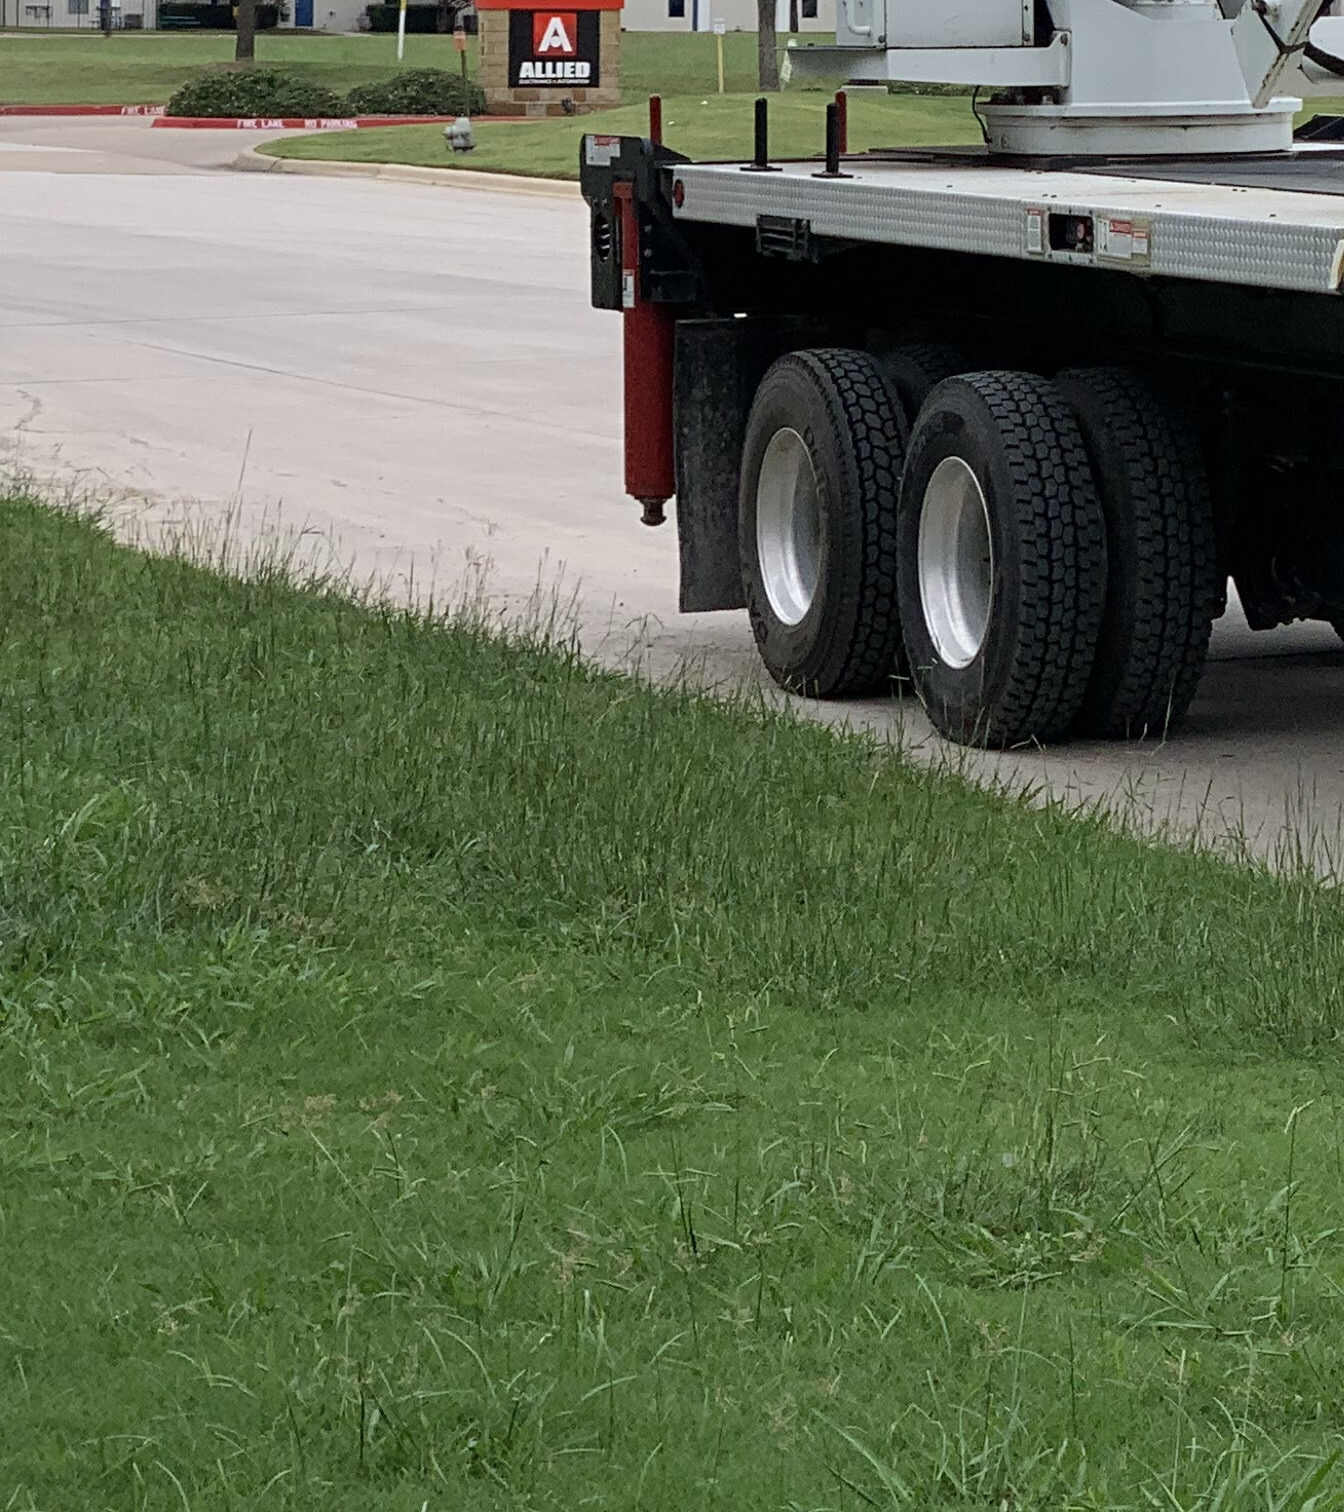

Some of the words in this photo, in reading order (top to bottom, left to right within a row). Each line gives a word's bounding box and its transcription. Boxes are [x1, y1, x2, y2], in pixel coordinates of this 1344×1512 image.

[518, 61, 591, 79] ALLIED
[236, 118, 257, 129] FIRE
[260, 119, 285, 129] LANE
